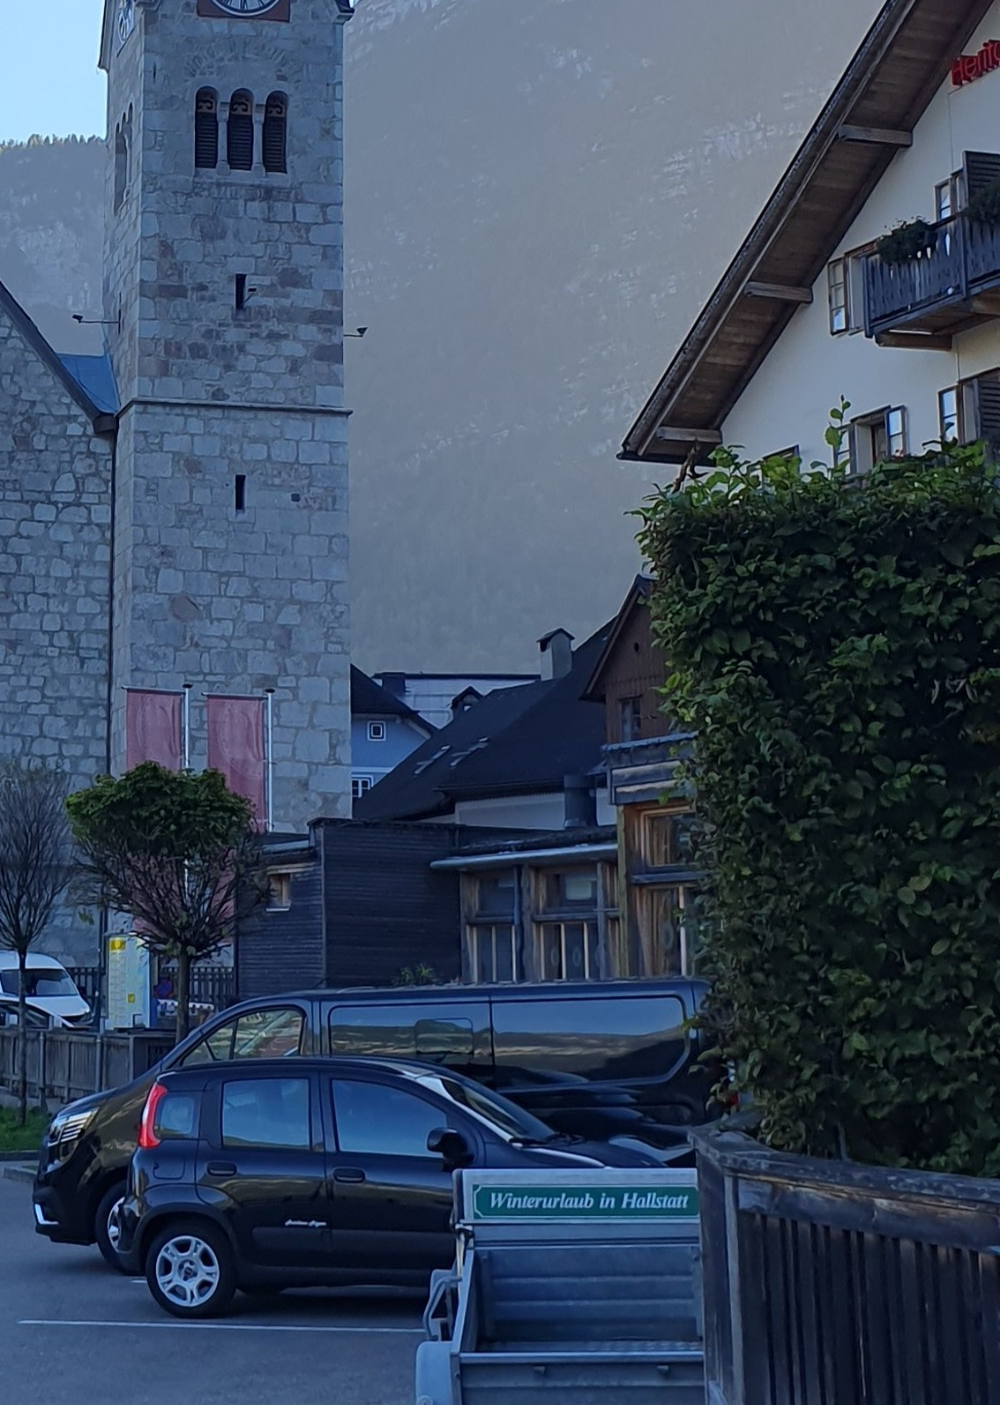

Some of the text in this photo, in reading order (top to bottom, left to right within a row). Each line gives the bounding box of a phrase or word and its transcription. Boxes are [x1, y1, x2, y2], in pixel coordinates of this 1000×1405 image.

[490, 1192, 688, 1210] Winterurlaub in Hallstatt
